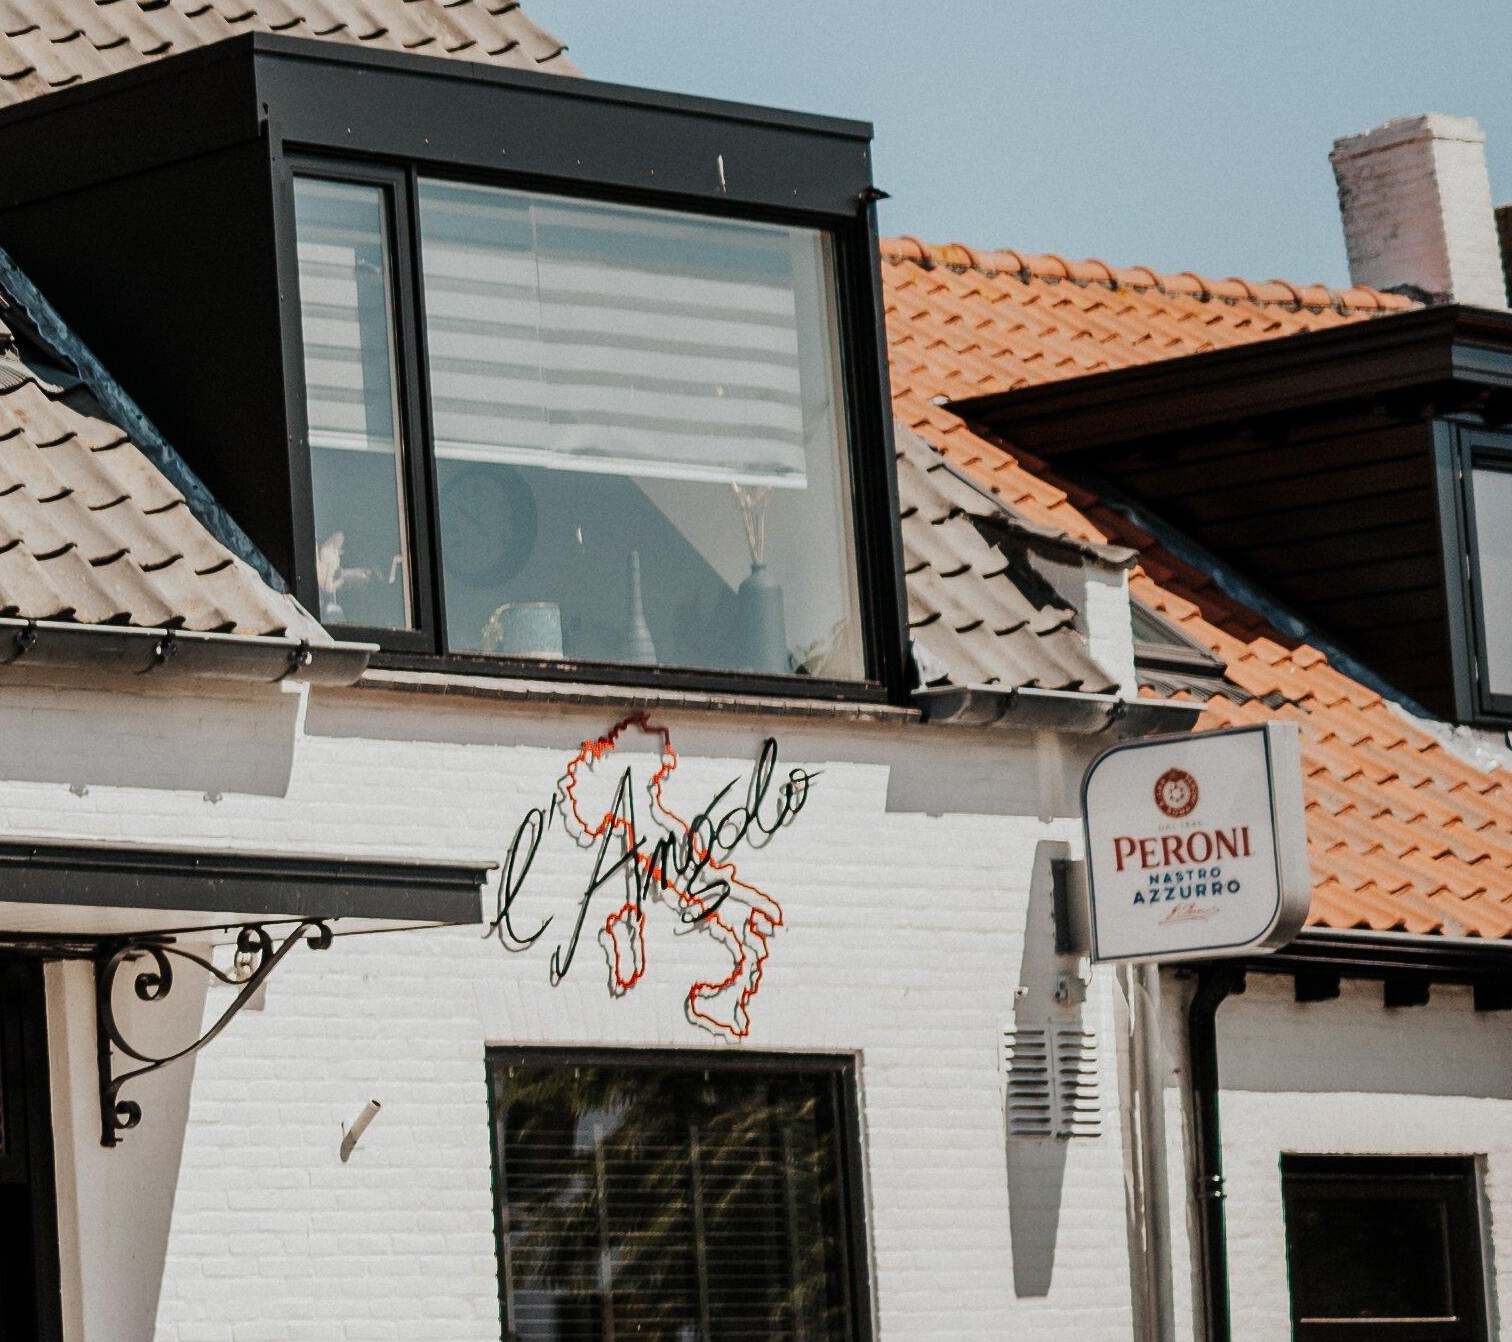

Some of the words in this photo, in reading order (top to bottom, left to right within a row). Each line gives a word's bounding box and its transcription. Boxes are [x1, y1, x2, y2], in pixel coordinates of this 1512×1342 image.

[1113, 826, 1252, 872] PERONI
[1149, 866, 1222, 885] NASTRO
[1133, 879, 1241, 905] AZZURRO
